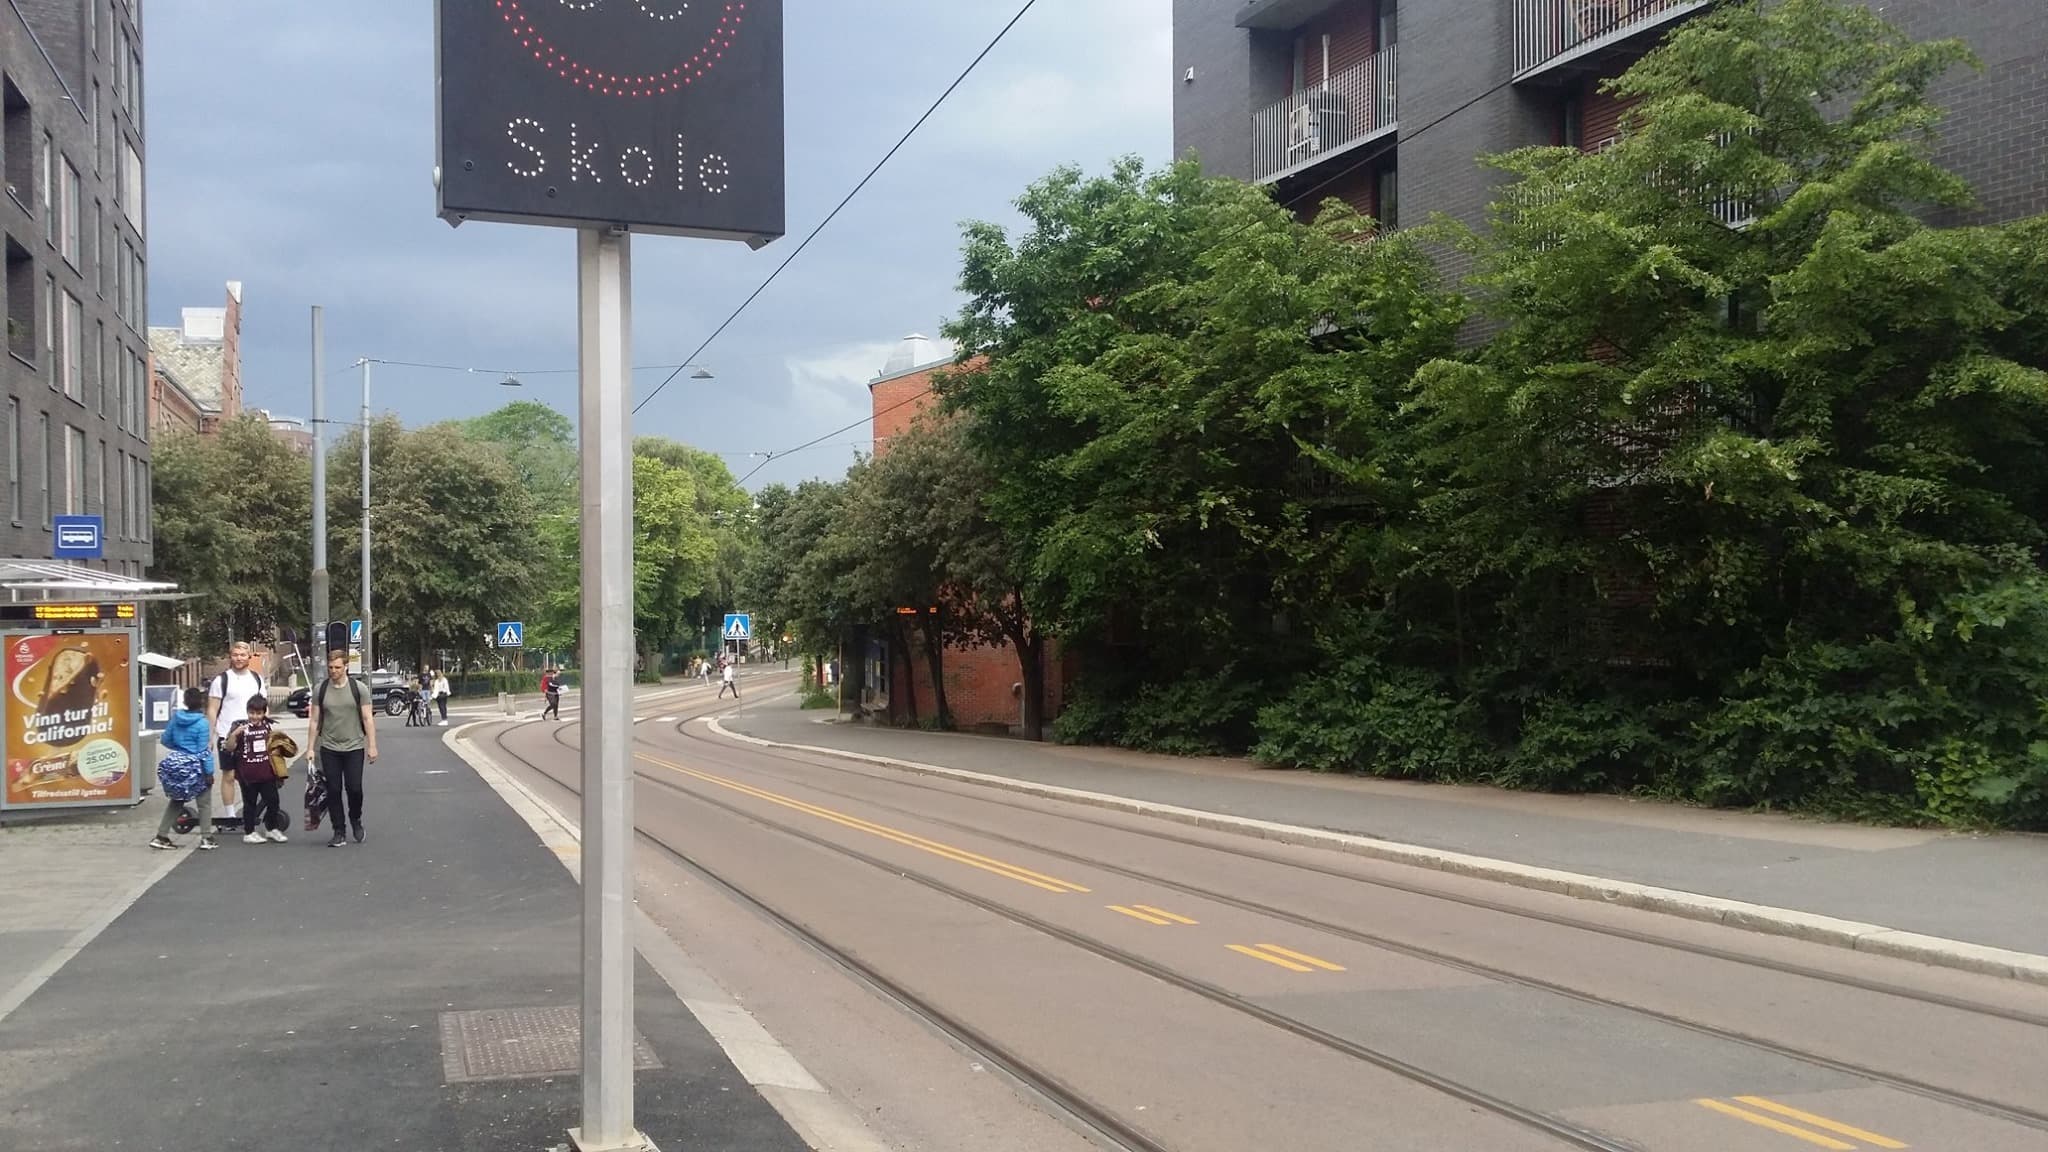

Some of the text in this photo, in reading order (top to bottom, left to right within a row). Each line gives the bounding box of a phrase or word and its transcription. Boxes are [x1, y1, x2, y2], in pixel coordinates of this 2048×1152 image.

[506, 117, 729, 194] Skole
[23, 702, 109, 729] Vinn tur til
[23, 717, 113, 745] California!
